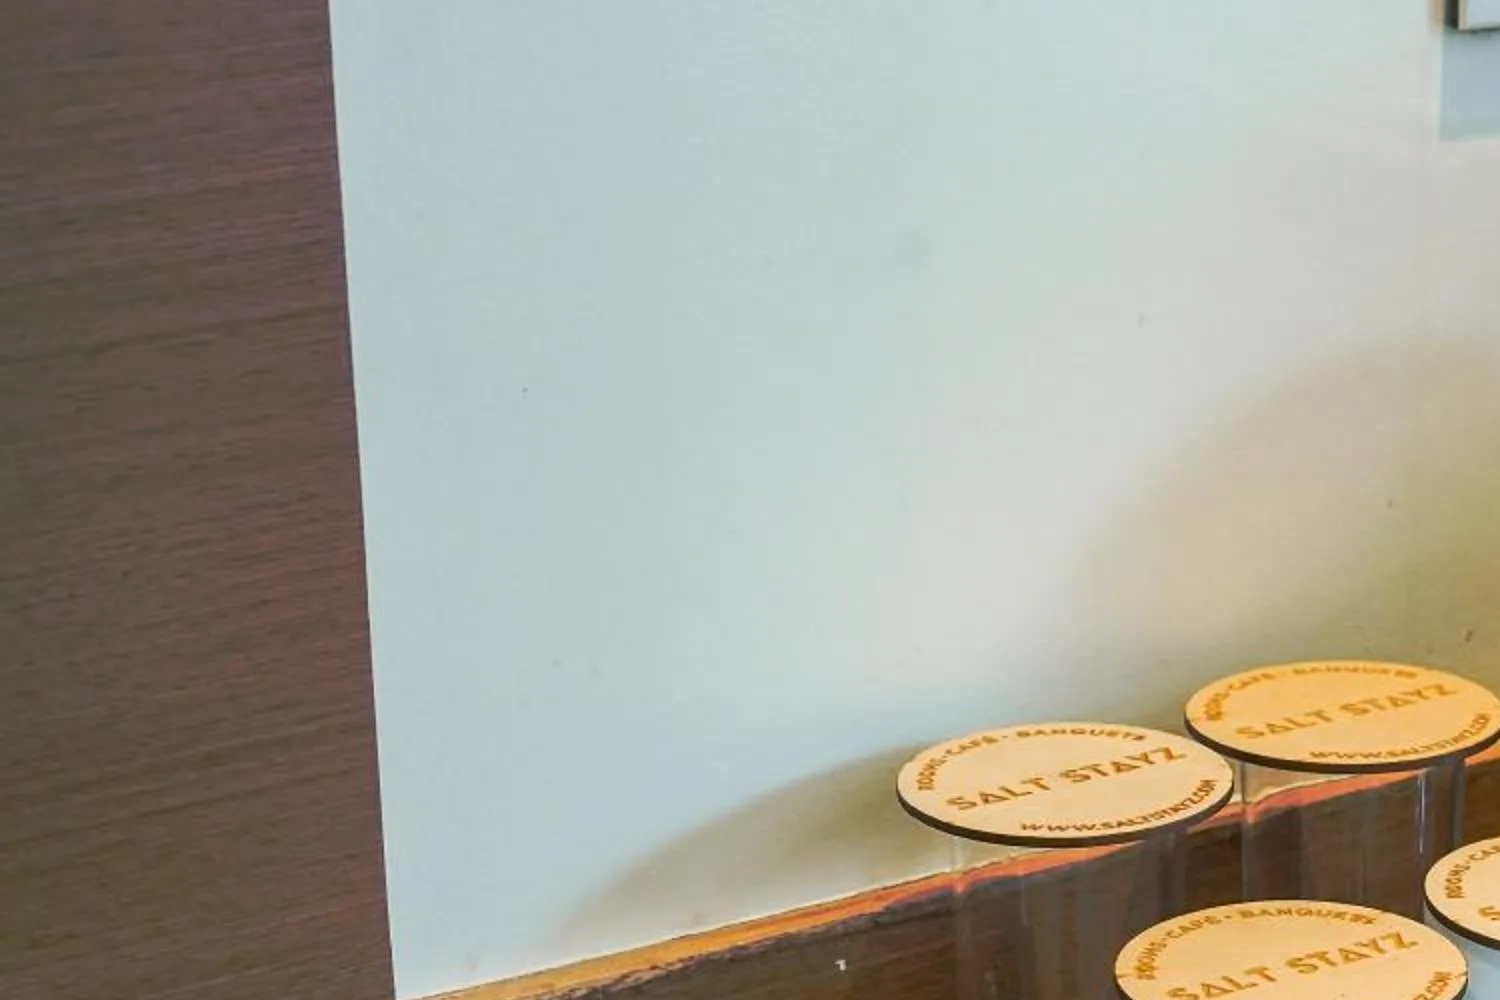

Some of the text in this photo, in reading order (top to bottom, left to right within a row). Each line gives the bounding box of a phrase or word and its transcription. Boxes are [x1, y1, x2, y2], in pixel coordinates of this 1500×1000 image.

[1234, 682, 1457, 740] SALT STAYZ
[947, 745, 1188, 812] SALT STAYZ
[1286, 930, 1420, 976] STAYZ
